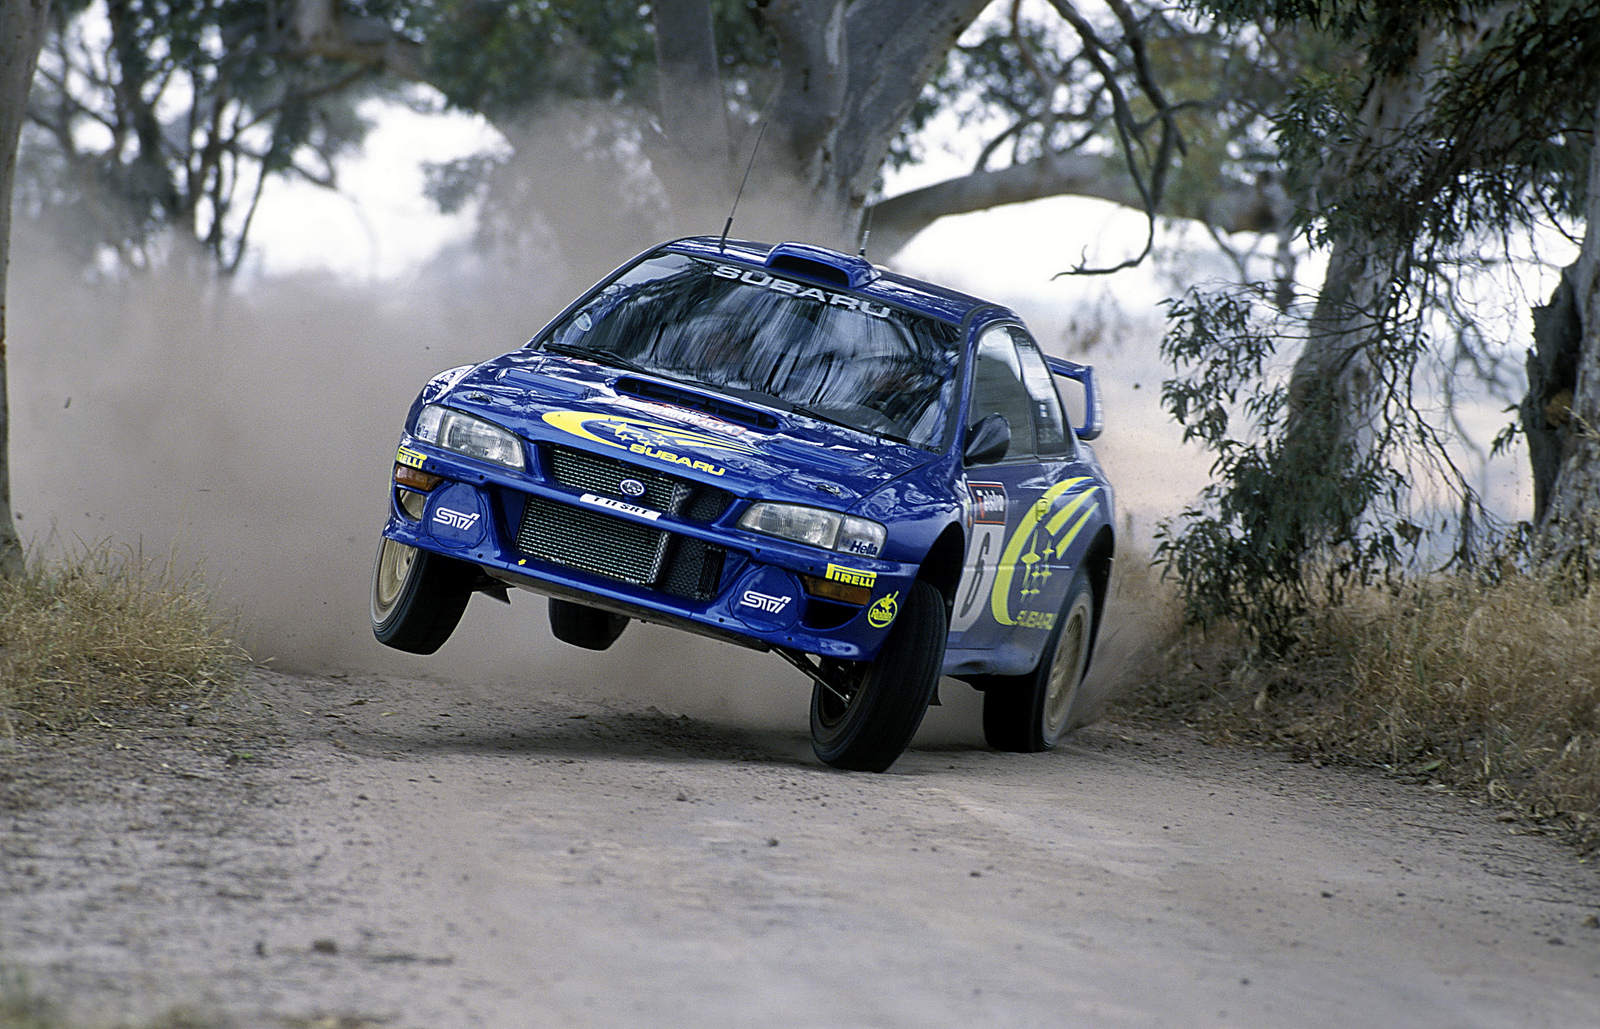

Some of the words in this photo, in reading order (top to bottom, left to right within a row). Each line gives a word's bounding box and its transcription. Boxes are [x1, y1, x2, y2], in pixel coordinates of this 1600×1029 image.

[712, 266, 891, 318] SUBARU
[629, 443, 726, 477] SUBARU
[849, 540, 878, 556] Hella
[825, 562, 877, 588] PIRELLI
[959, 531, 991, 618] 6
